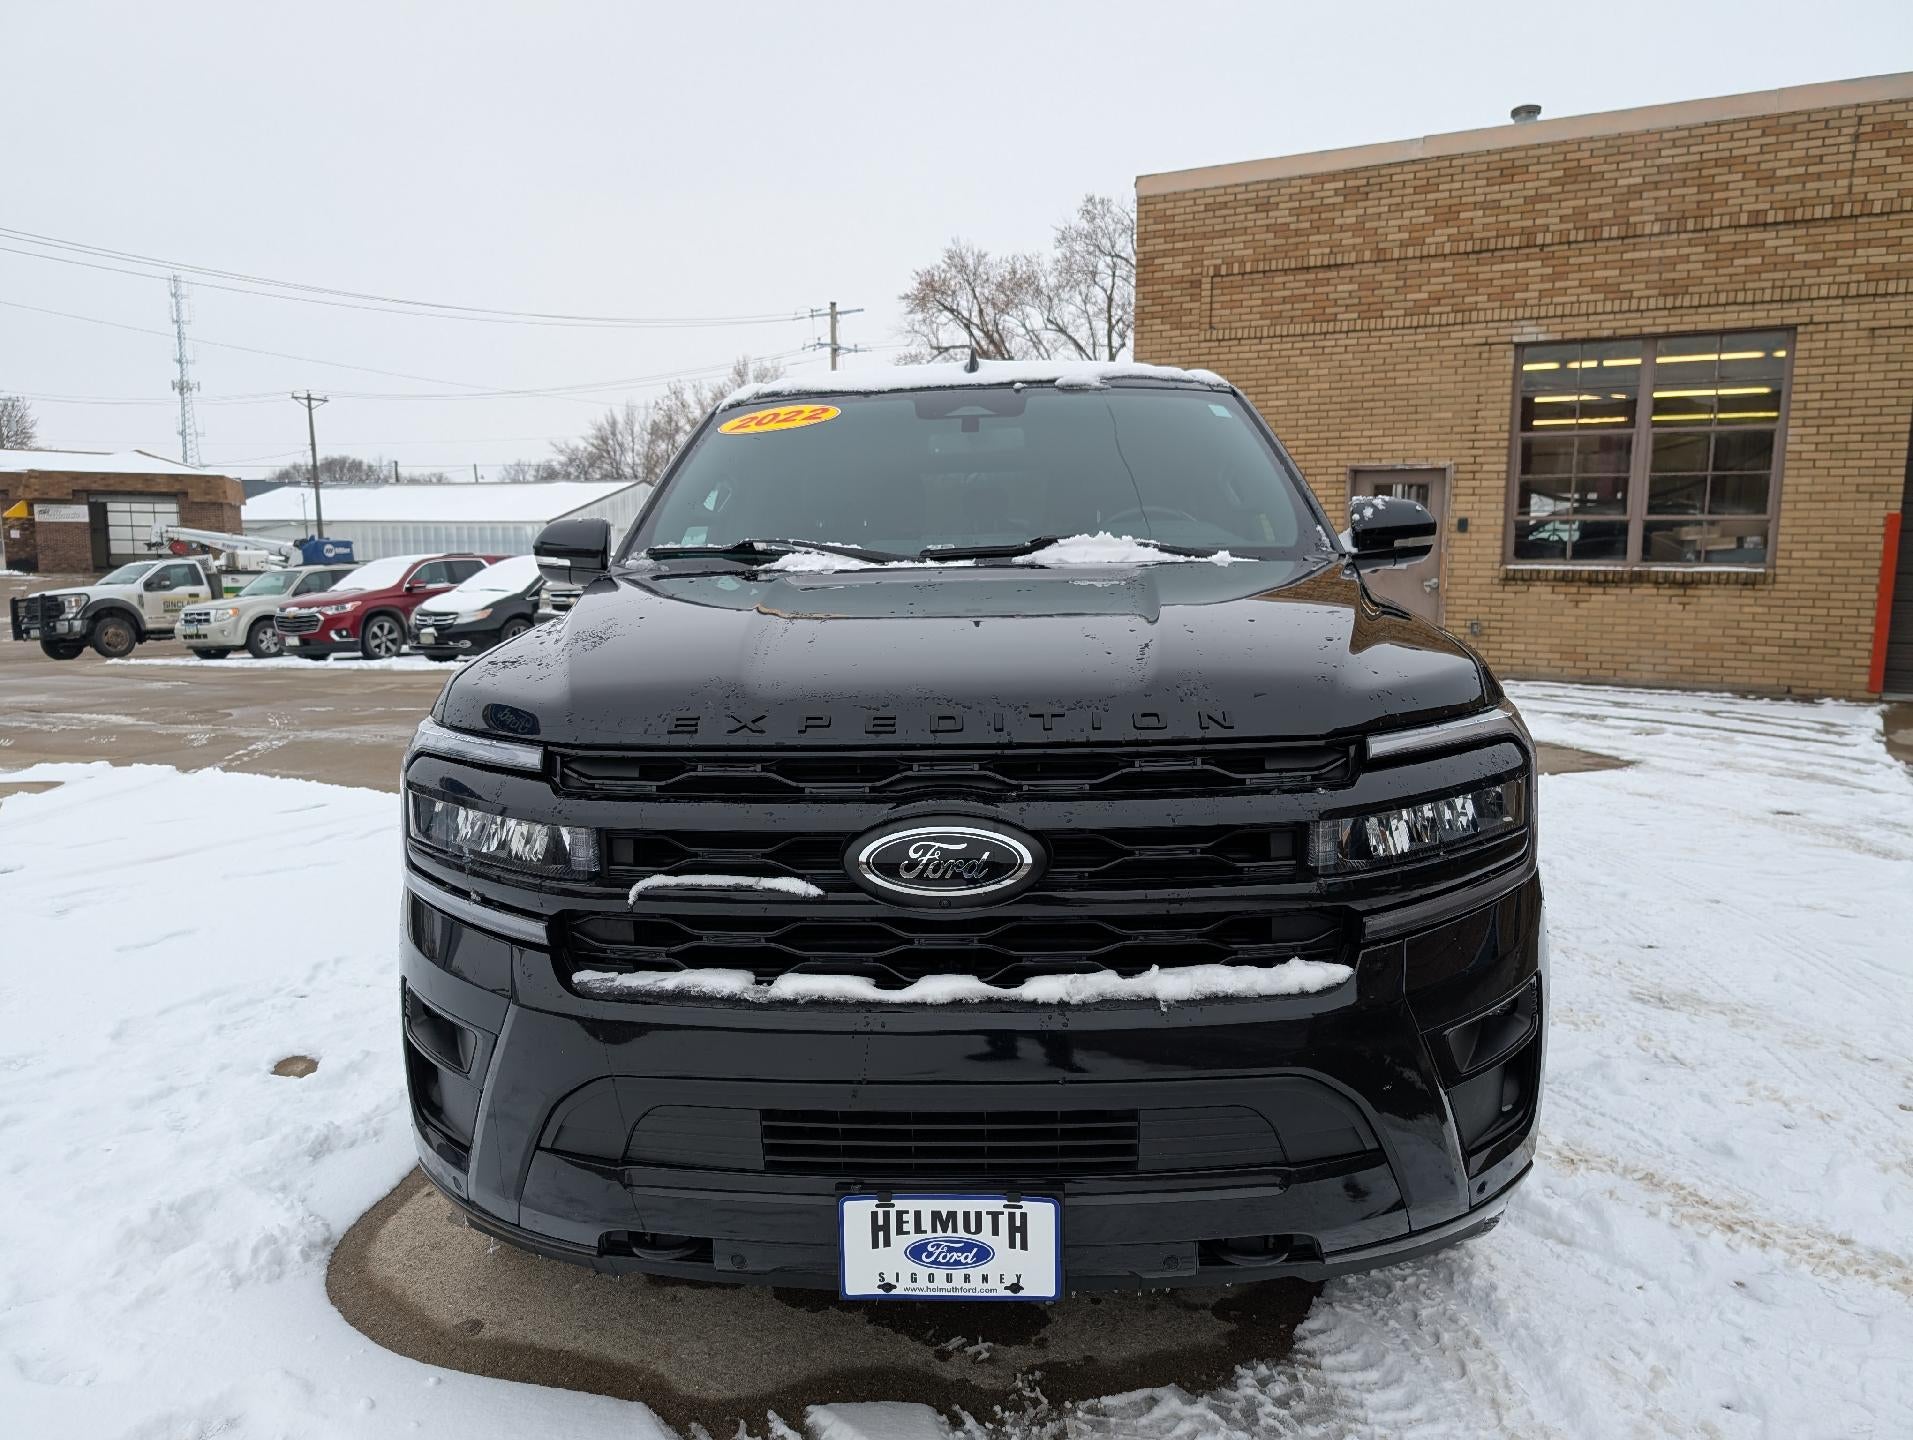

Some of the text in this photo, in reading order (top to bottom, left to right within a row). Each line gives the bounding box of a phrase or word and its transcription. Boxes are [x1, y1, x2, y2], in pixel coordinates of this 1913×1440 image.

[728, 407, 830, 431] 2022
[667, 711, 1235, 735] EXPEDITION
[899, 841, 990, 879] Ford
[870, 1209, 1029, 1251] HELMUTH
[921, 1241, 978, 1264] Ford
[878, 1272, 1023, 1284] SIGOURNEY
[903, 1285, 998, 1294] www.helmuthford.com
